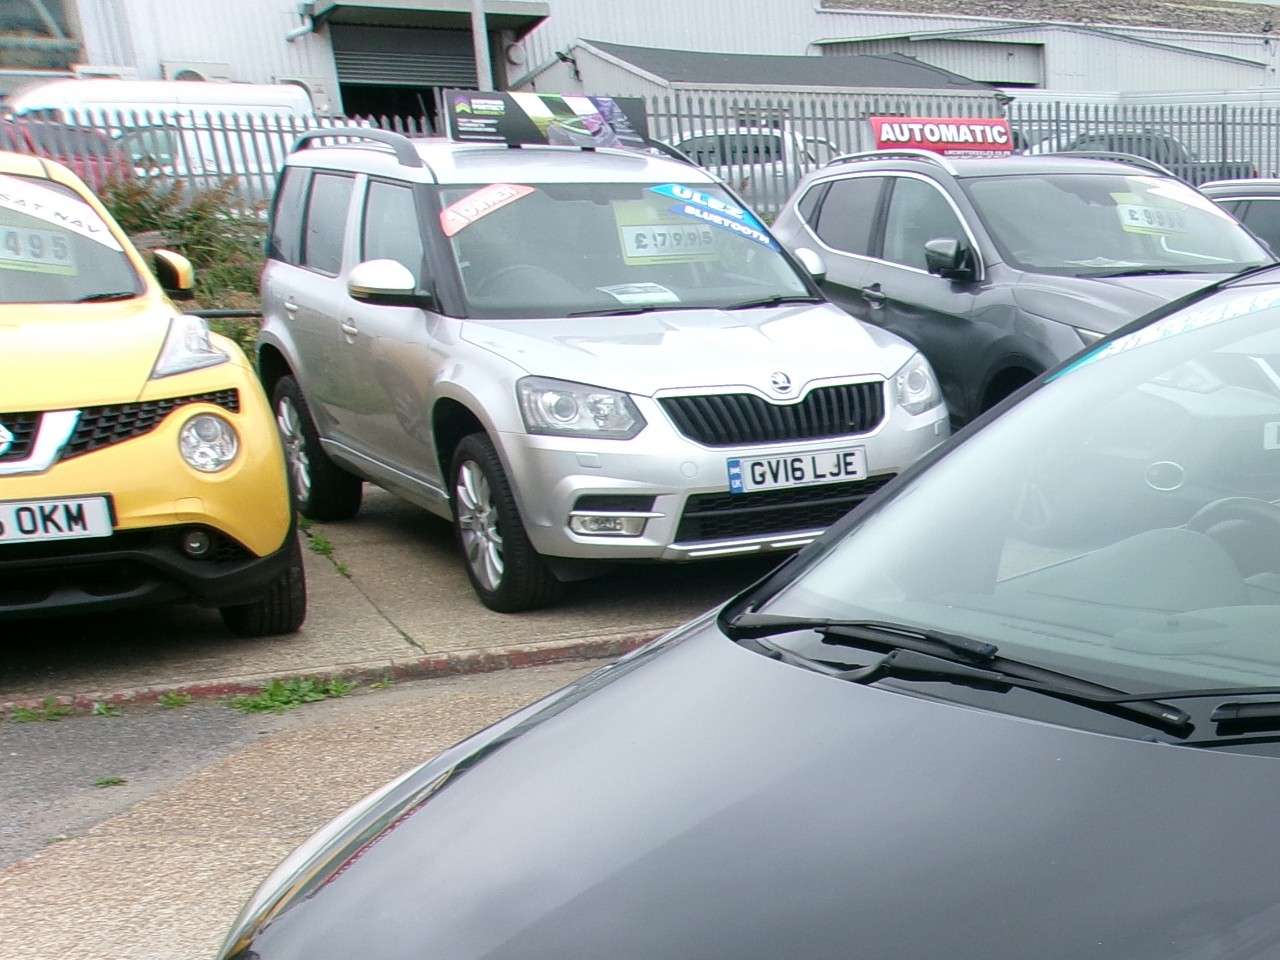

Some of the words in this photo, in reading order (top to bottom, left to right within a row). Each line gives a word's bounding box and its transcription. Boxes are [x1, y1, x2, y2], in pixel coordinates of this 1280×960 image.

[880, 123, 1008, 144] AUTOMATIC
[751, 458, 805, 485] GV16
[812, 452, 858, 479] LJE
